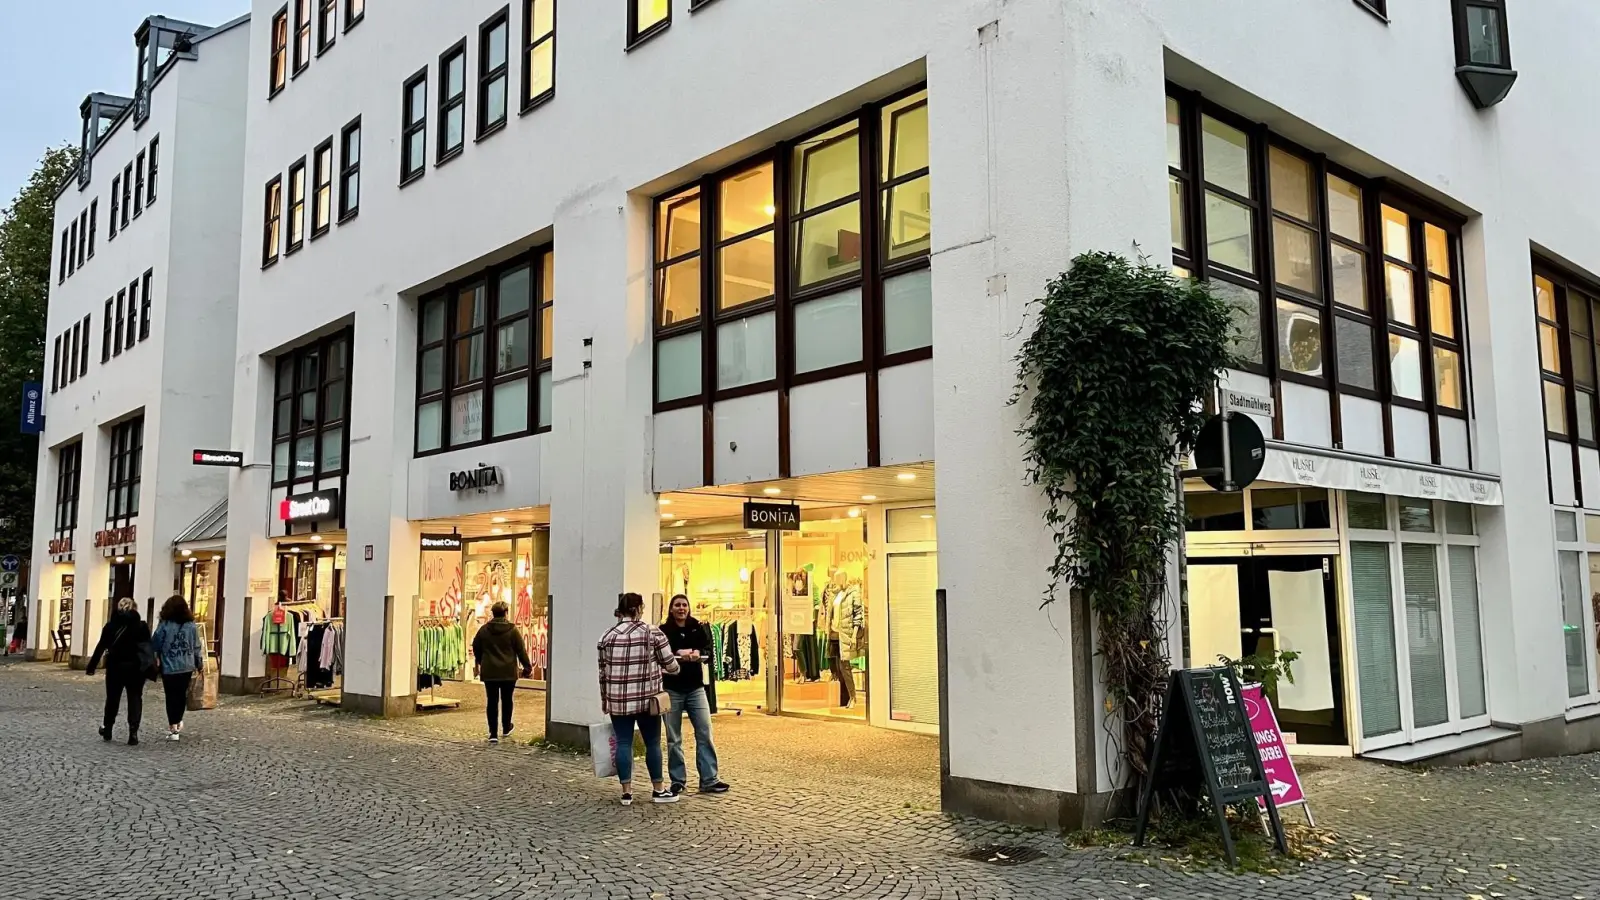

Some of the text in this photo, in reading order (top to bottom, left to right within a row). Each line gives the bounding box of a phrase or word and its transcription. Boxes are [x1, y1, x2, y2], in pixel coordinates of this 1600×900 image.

[27, 400, 36, 425] Allianz
[1229, 393, 1272, 415] Stadtmühlweg
[1292, 458, 1316, 472] HUSSEL
[751, 507, 796, 526] BONITA
[421, 538, 461, 547] Street One
[424, 557, 444, 581] WIR
[1253, 728, 1278, 745] UNGS
[1259, 745, 1284, 762] IDEREI
